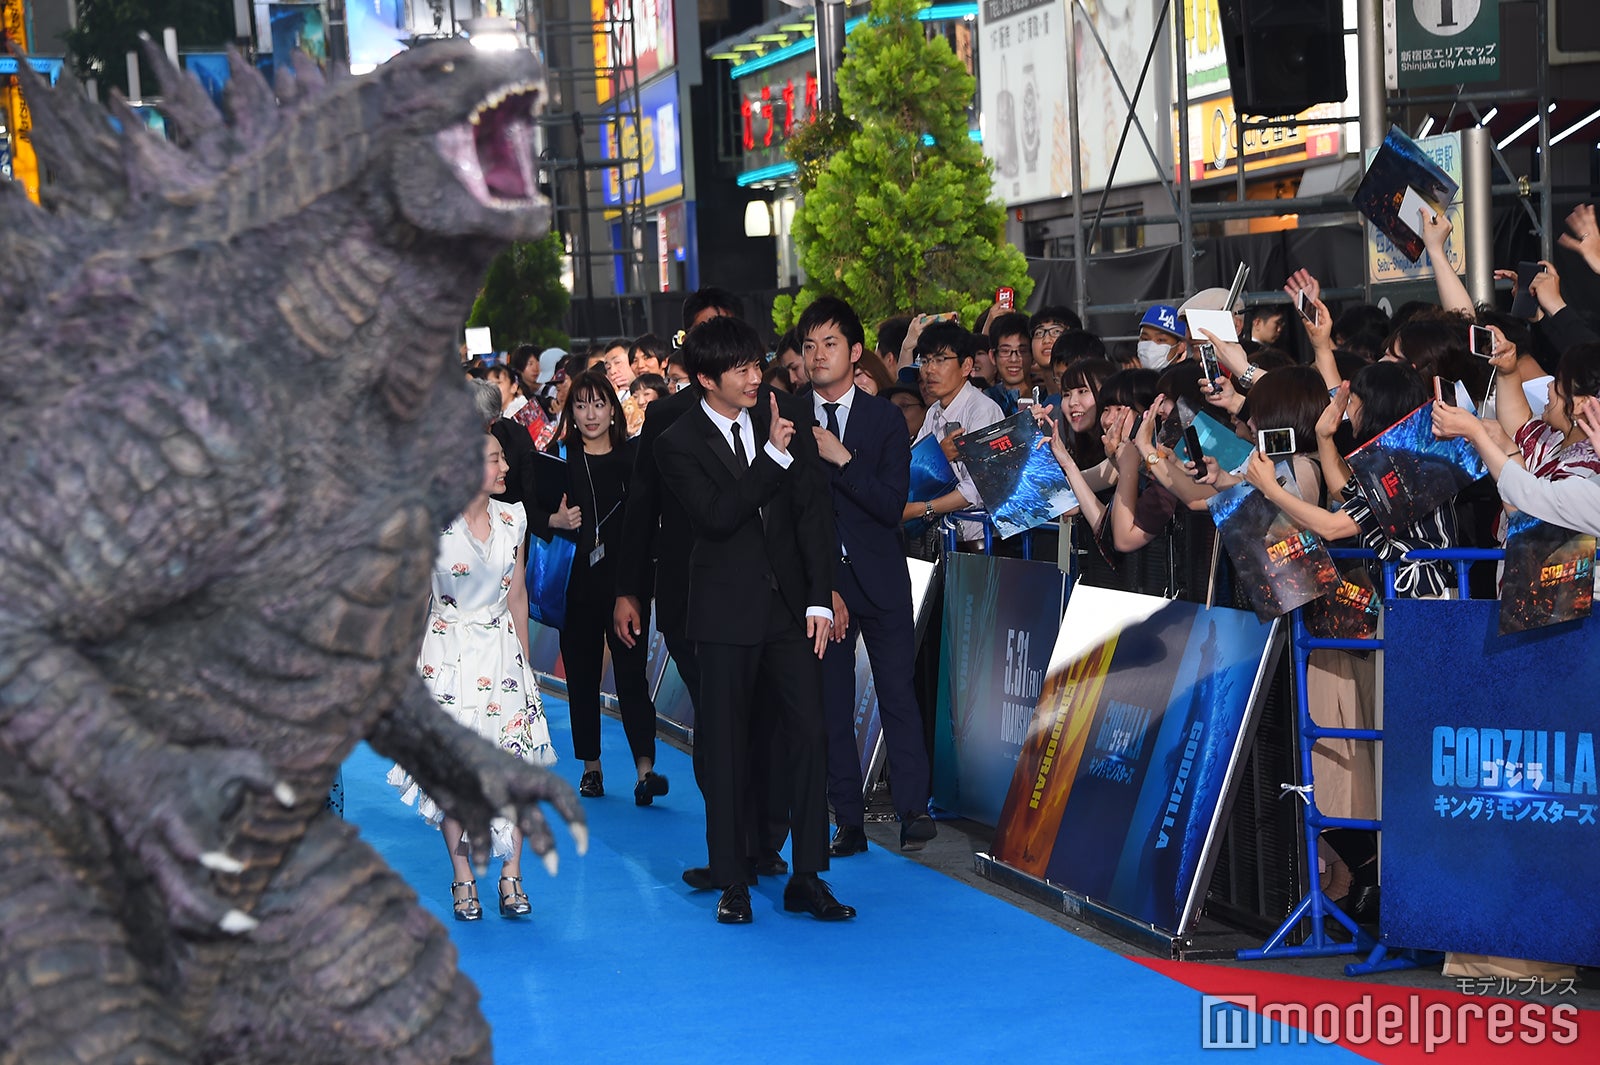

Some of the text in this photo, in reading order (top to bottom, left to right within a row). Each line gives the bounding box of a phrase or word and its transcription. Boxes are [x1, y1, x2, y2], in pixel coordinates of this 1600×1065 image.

[1400, 42, 1496, 62] 新宿区エリアマップ
[1401, 55, 1496, 72] Shinjuku City Area Map
[1158, 308, 1176, 331] LA
[1432, 725, 1597, 796] GODZILLA
[1482, 758, 1544, 791] ゴジラ
[1155, 720, 1205, 849] GODZILLA
